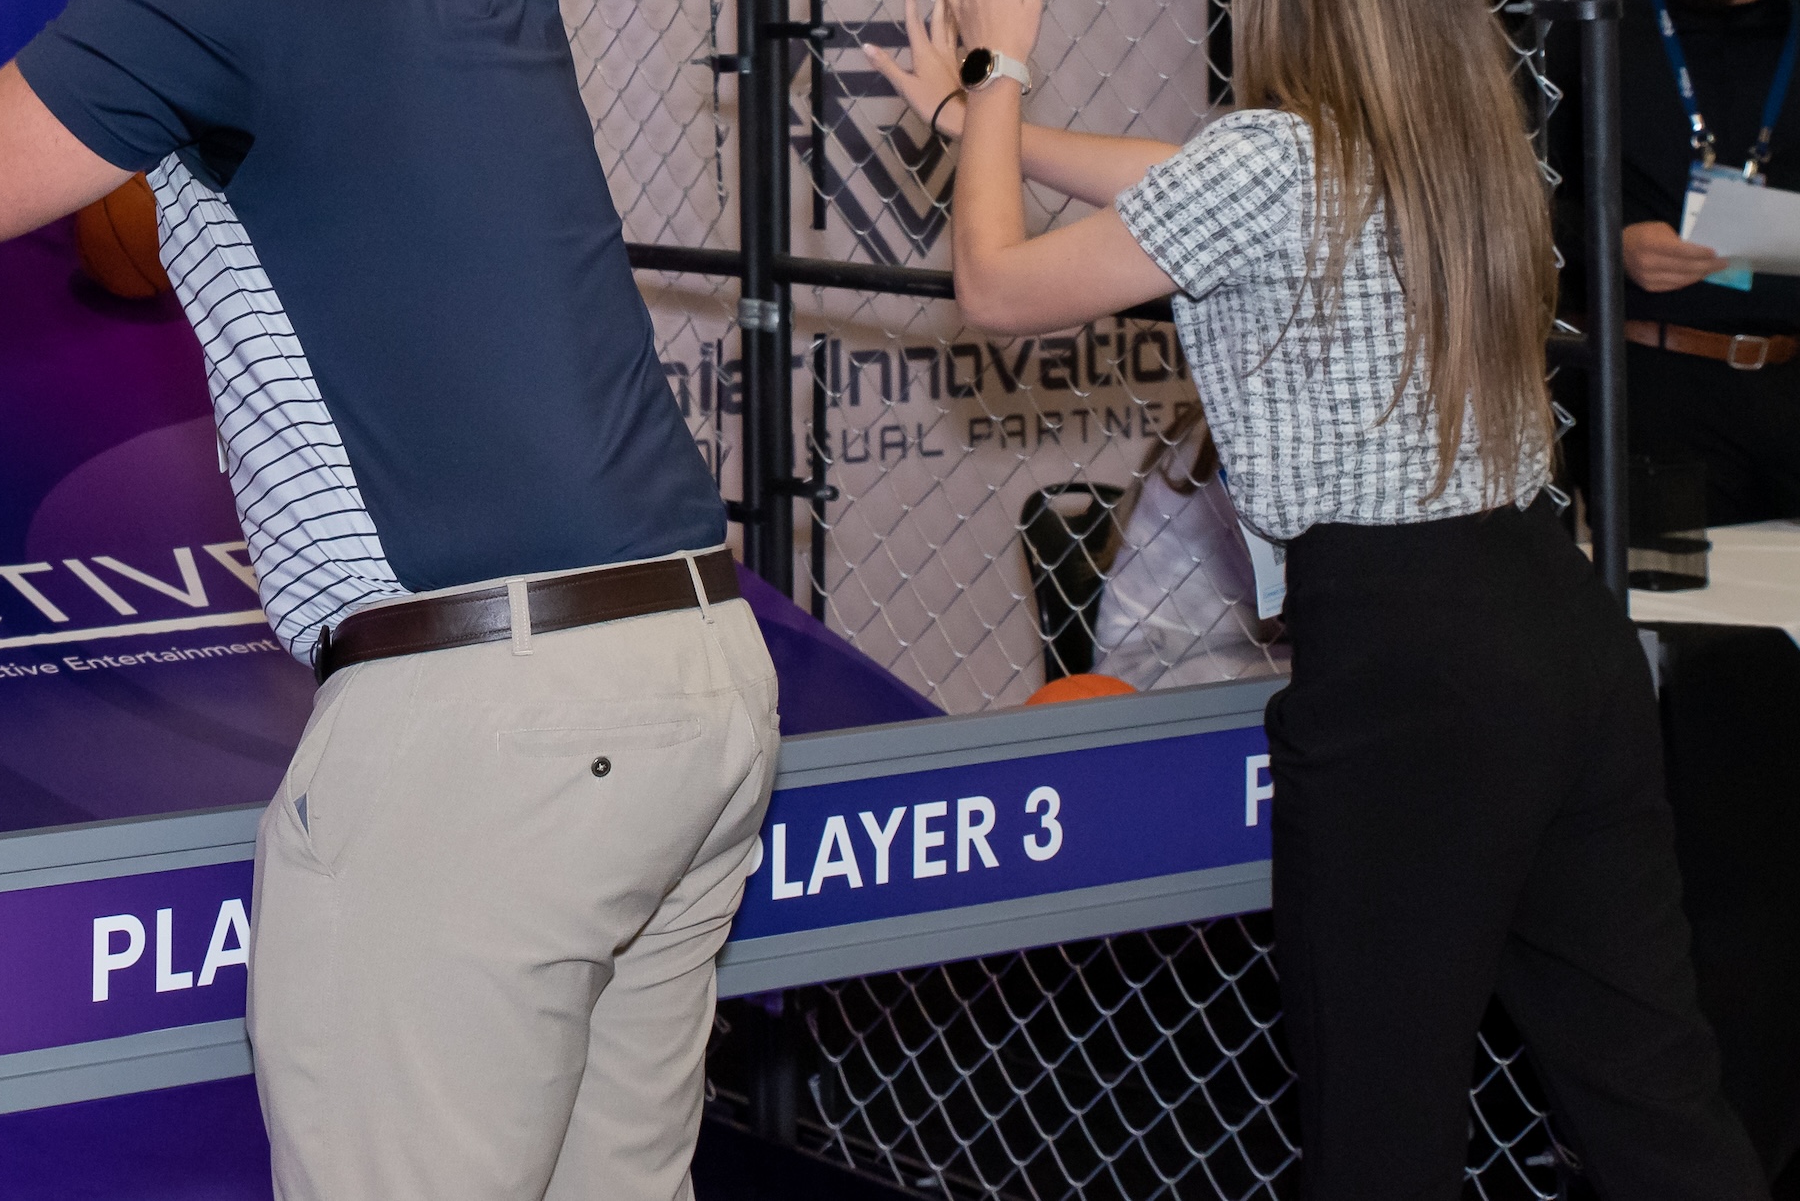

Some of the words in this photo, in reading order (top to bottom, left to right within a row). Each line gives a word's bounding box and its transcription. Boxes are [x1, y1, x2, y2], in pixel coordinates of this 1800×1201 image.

[64, 638, 280, 672] Entertainment
[747, 796, 999, 900] LAYER
[1024, 786, 1062, 861] 3
